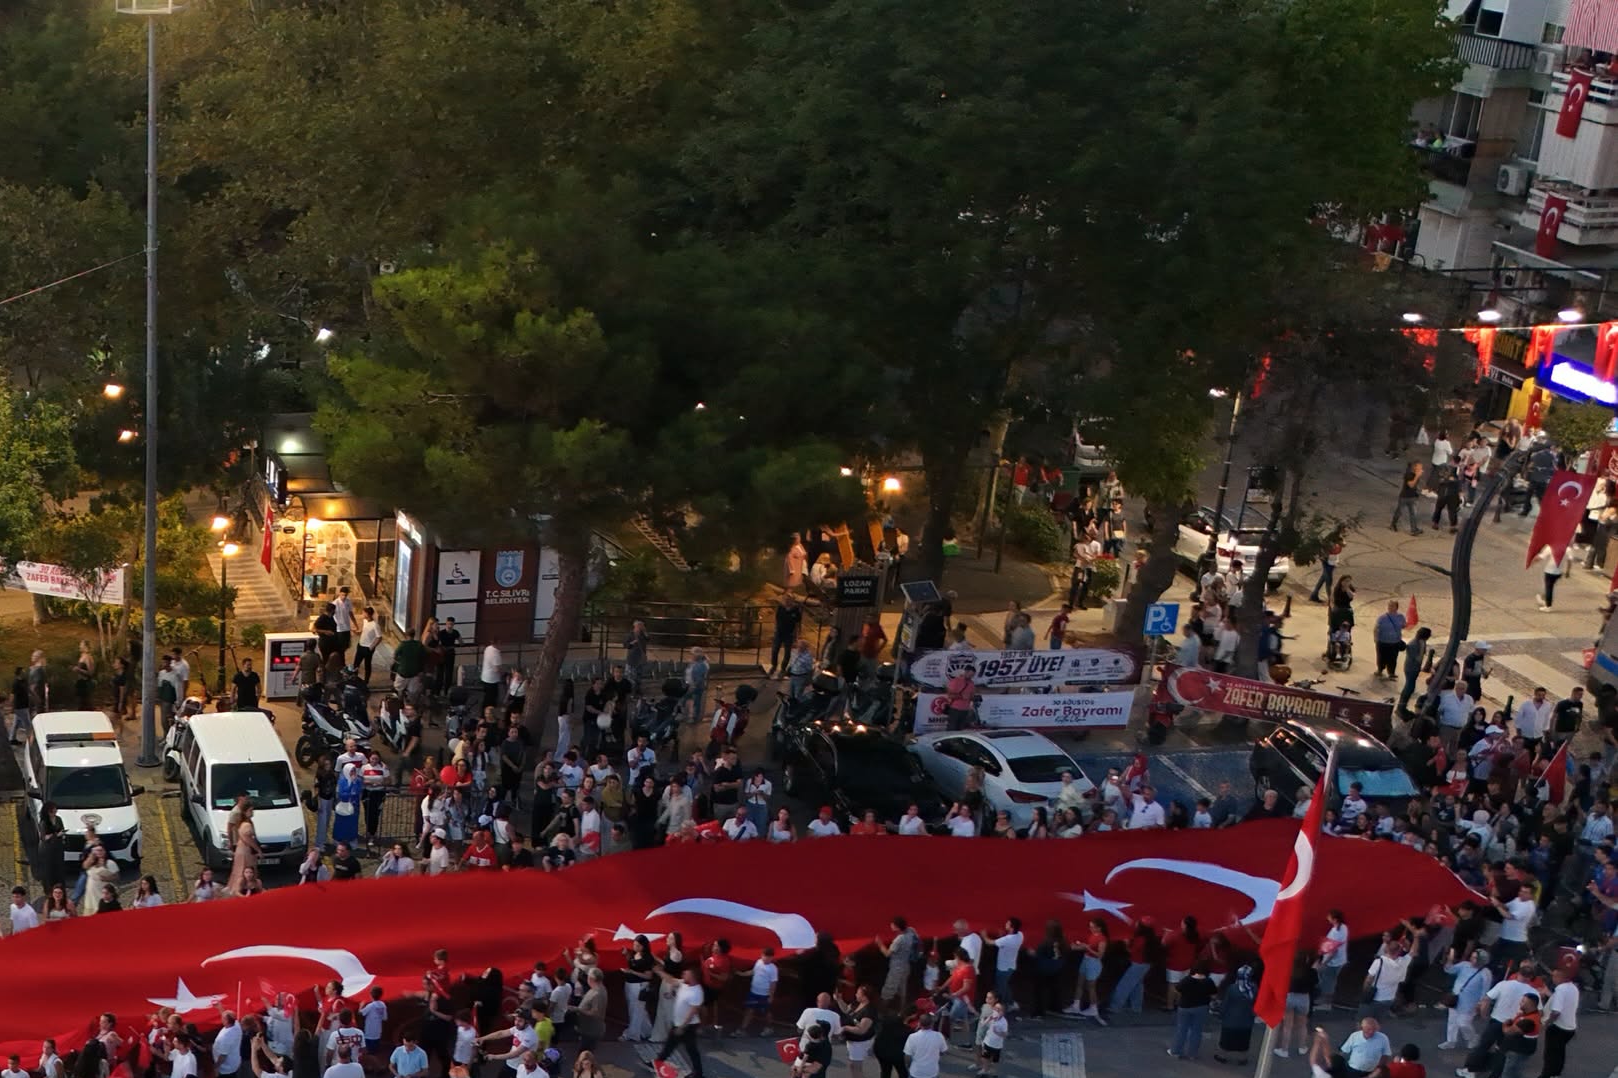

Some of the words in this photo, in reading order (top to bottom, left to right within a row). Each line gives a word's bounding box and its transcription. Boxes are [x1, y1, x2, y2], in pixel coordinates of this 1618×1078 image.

[1146, 606, 1166, 631] P
[978, 659, 1026, 677] 1957
[1027, 656, 1065, 673] ÜYE!
[1021, 706, 1059, 717] Zafer
[1063, 706, 1123, 719] Bayramı
[1223, 687, 1263, 708] ZAFER
[1267, 693, 1330, 718] BAYRAMI
